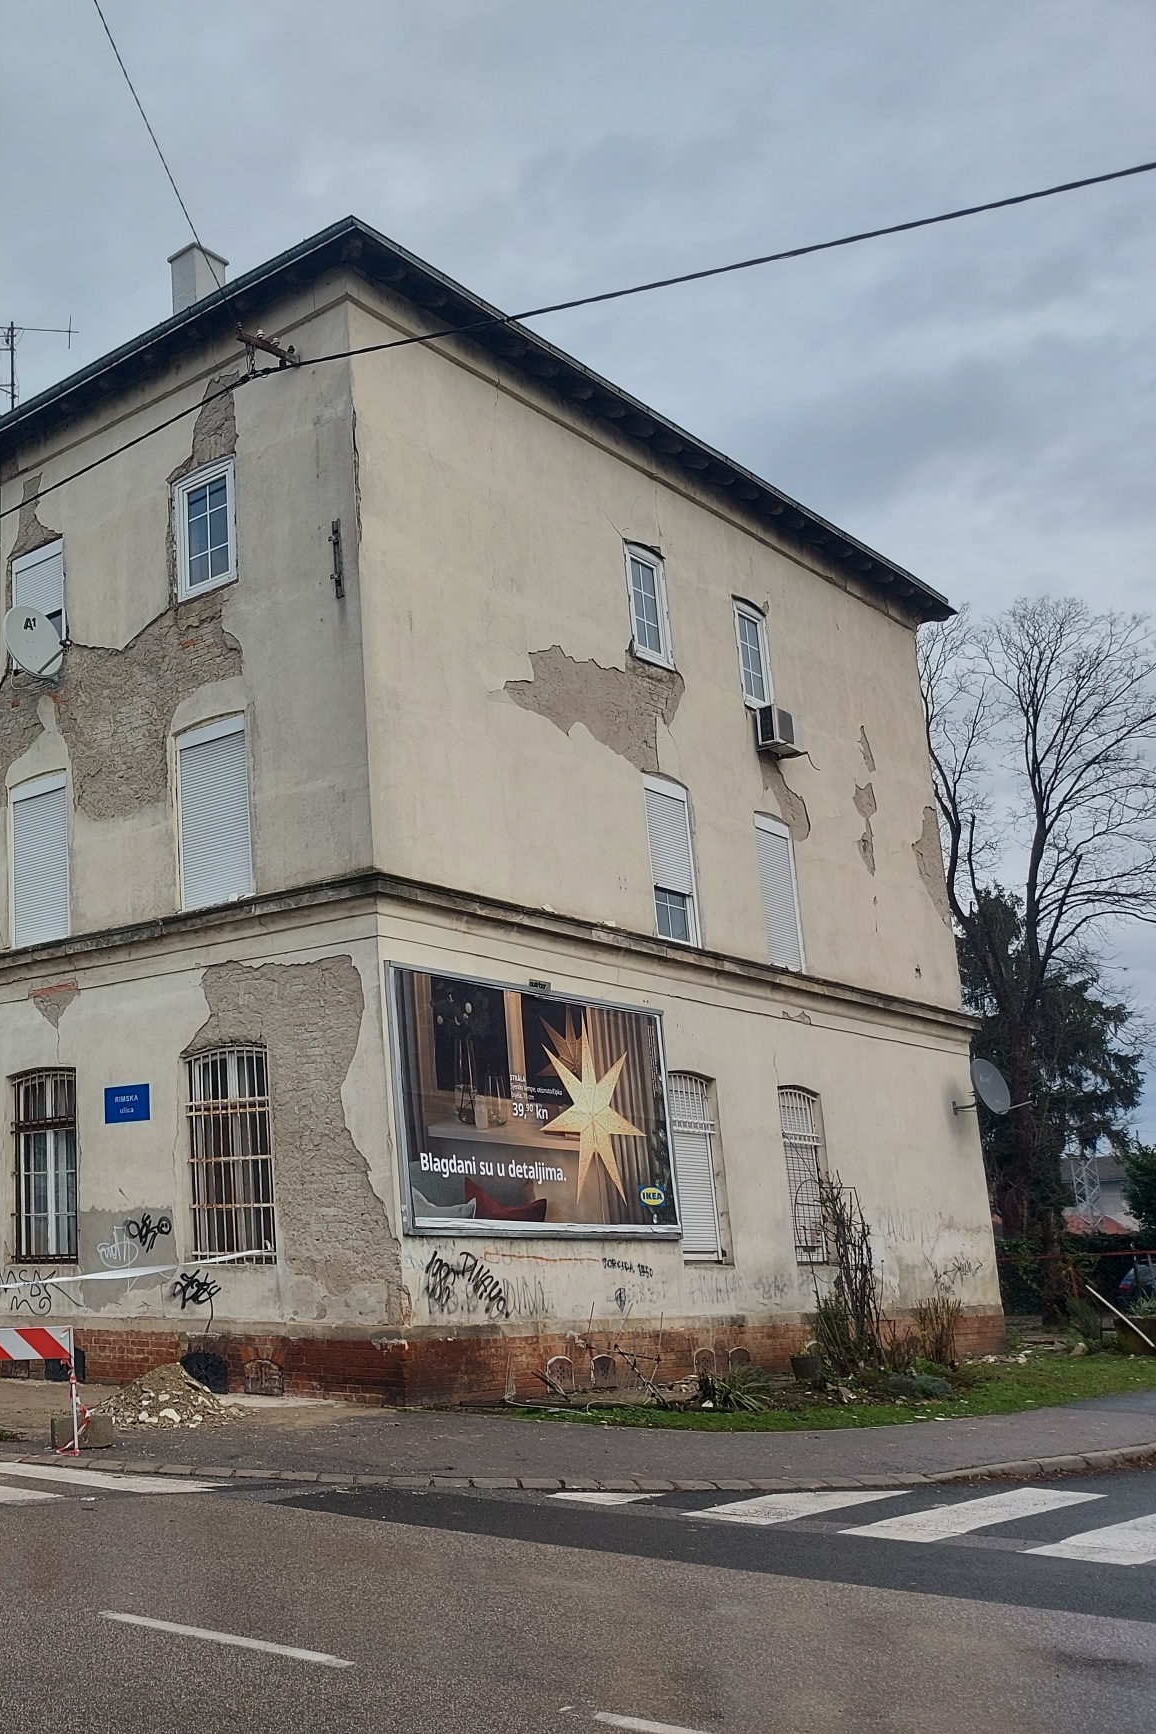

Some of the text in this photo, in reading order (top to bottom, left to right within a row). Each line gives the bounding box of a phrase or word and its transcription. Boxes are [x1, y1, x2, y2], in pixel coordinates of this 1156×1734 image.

[23, 617, 37, 631] A1
[114, 1094, 139, 1104] RIMSKA
[119, 1106, 135, 1114] ulica
[536, 1104, 549, 1120] kn
[420, 1152, 567, 1185] Blagdani su u detaljima.
[642, 1192, 663, 1201] IKEA
